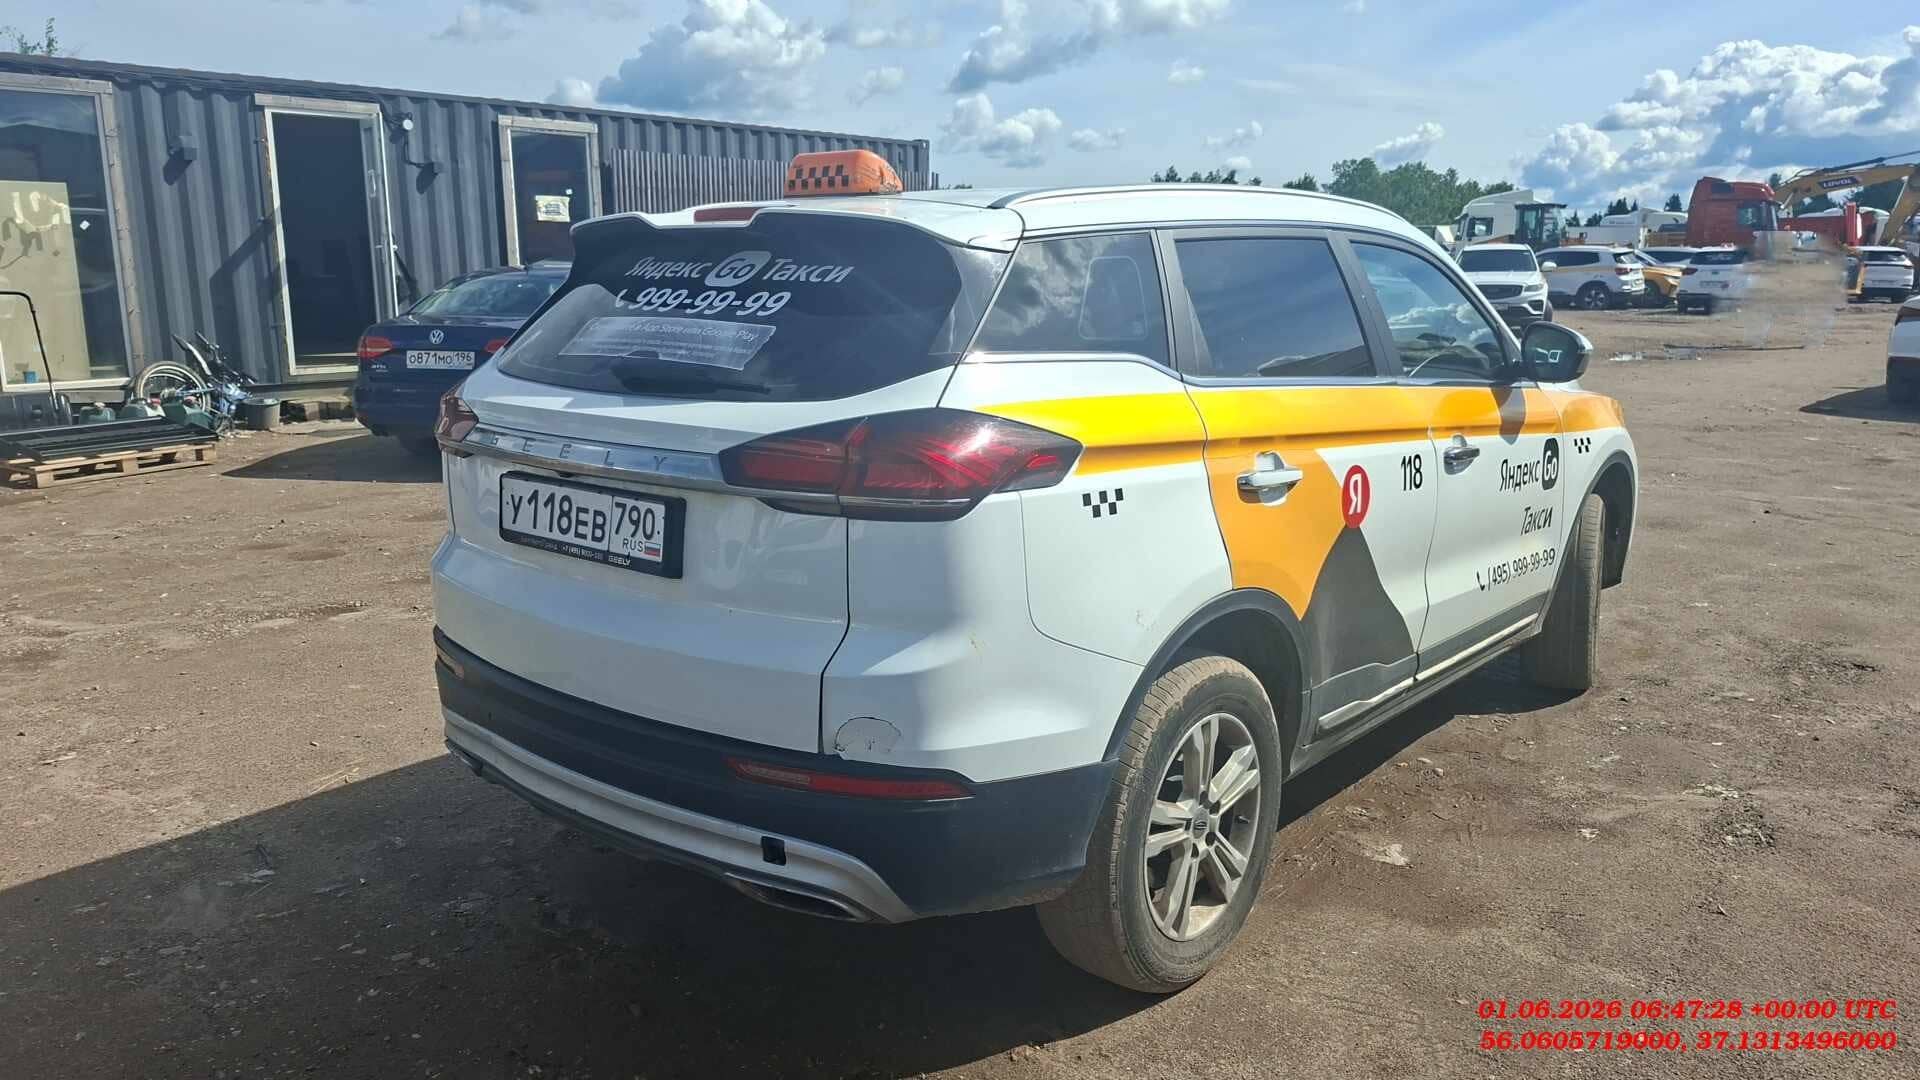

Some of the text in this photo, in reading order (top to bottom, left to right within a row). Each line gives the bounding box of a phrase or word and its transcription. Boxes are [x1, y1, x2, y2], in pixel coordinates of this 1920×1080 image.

[625, 256, 712, 280] Яндекс
[762, 258, 854, 283] Такси
[628, 287, 792, 317] 999-99-99
[1401, 453, 1423, 491] 118
[1499, 458, 1541, 492] Яндекс
[1348, 472, 1362, 516] Я
[614, 501, 656, 541] 790
[1520, 505, 1553, 536] Такси
[622, 537, 645, 553] RUS
[1487, 547, 1556, 591] (495) 999-99-99
